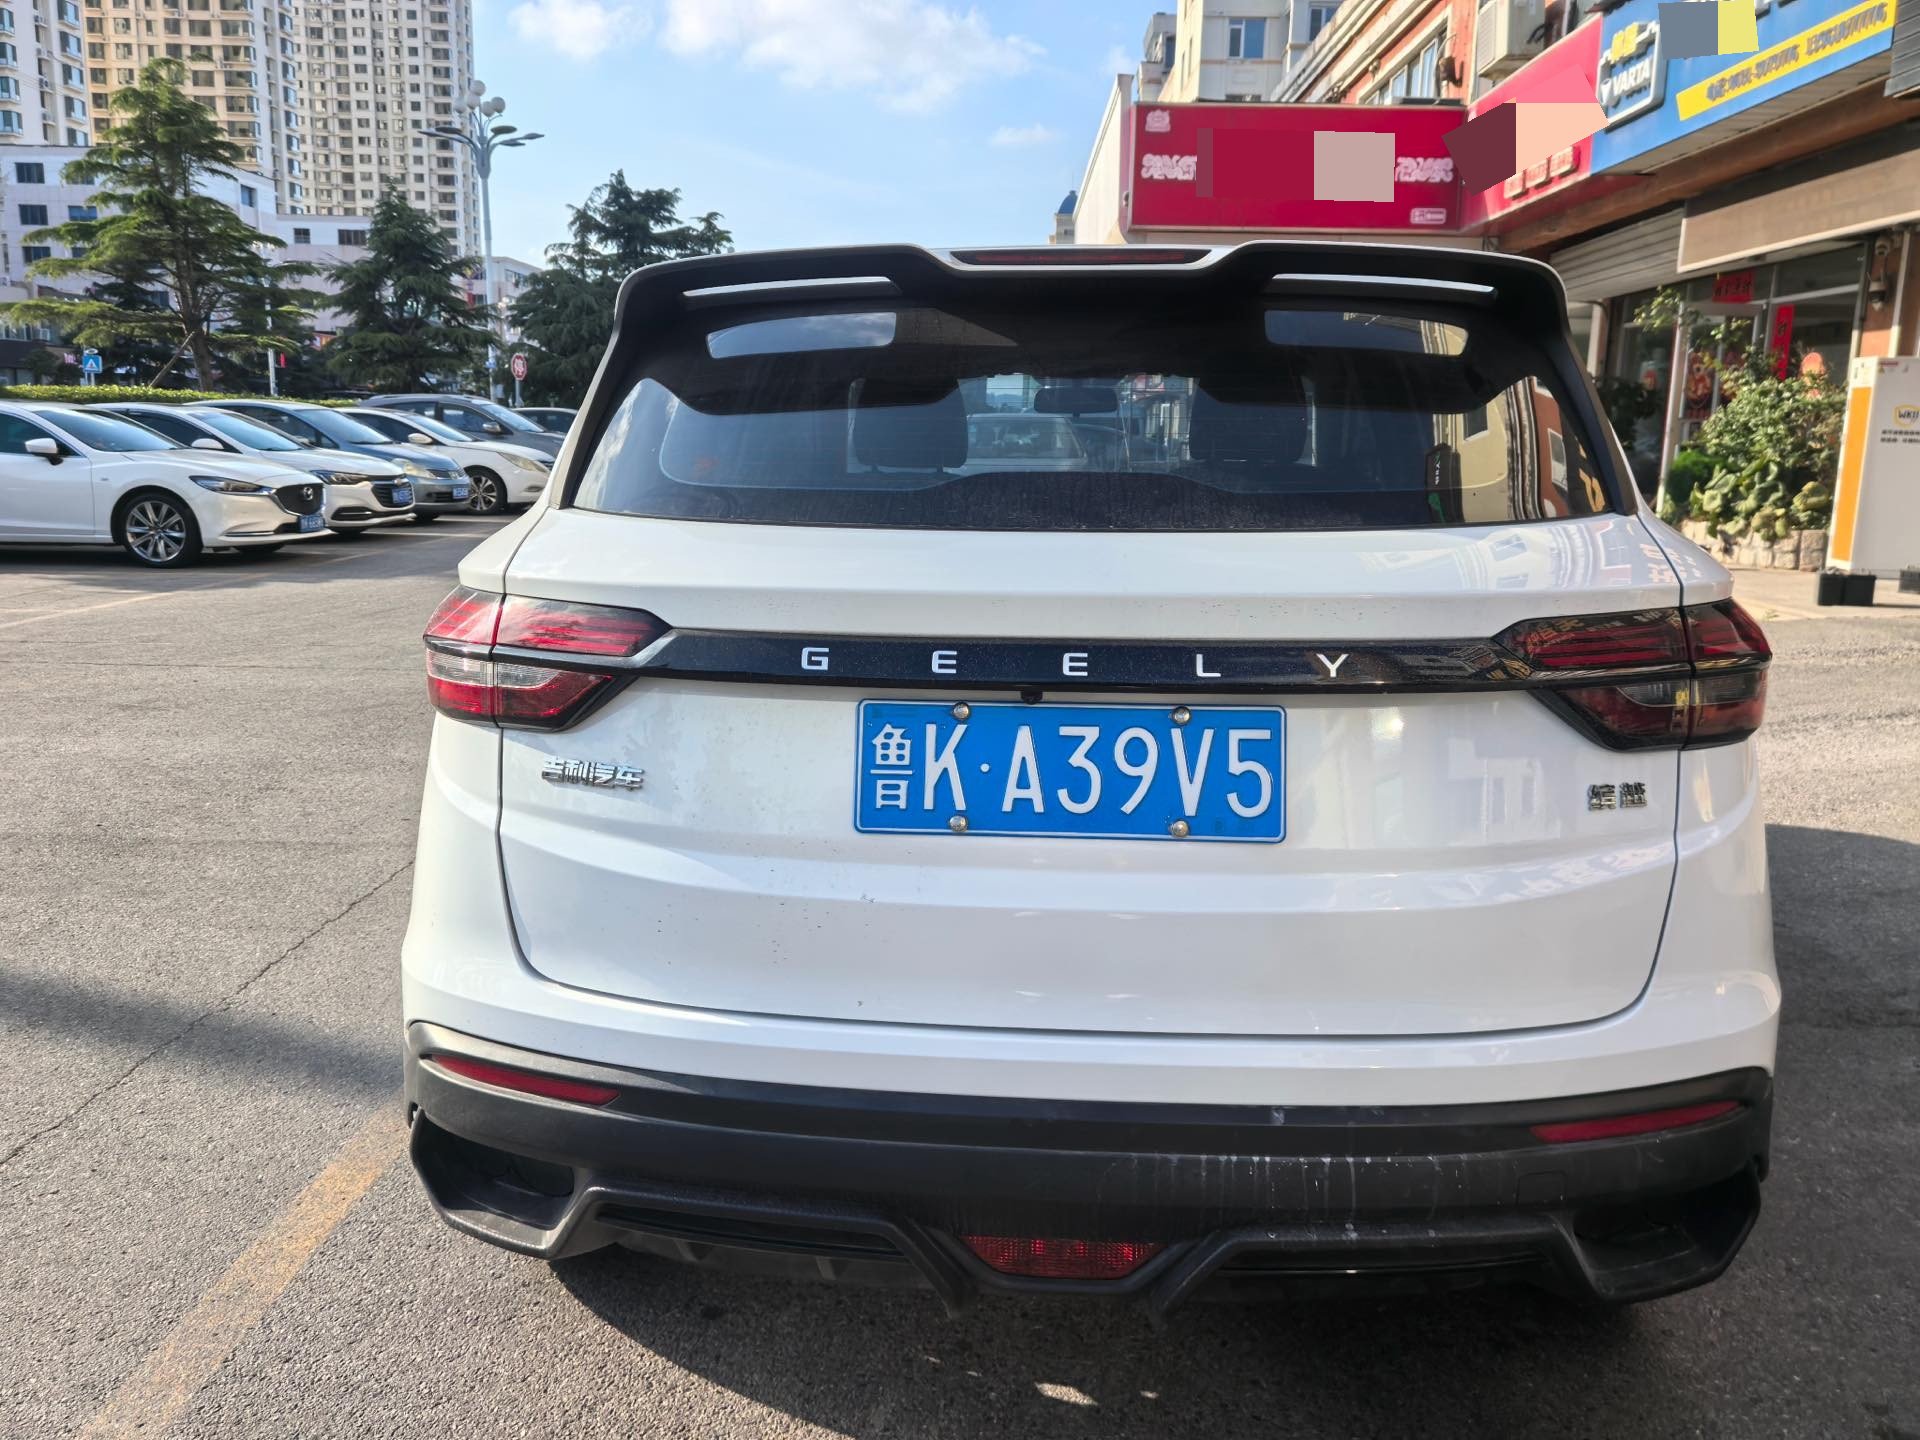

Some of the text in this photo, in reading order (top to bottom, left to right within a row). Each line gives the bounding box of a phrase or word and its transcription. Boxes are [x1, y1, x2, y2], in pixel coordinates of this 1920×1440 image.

[1612, 57, 1651, 97] VARTA
[801, 646, 1349, 678] GEELY
[870, 722, 1274, 819] 鲁K·A39V5
